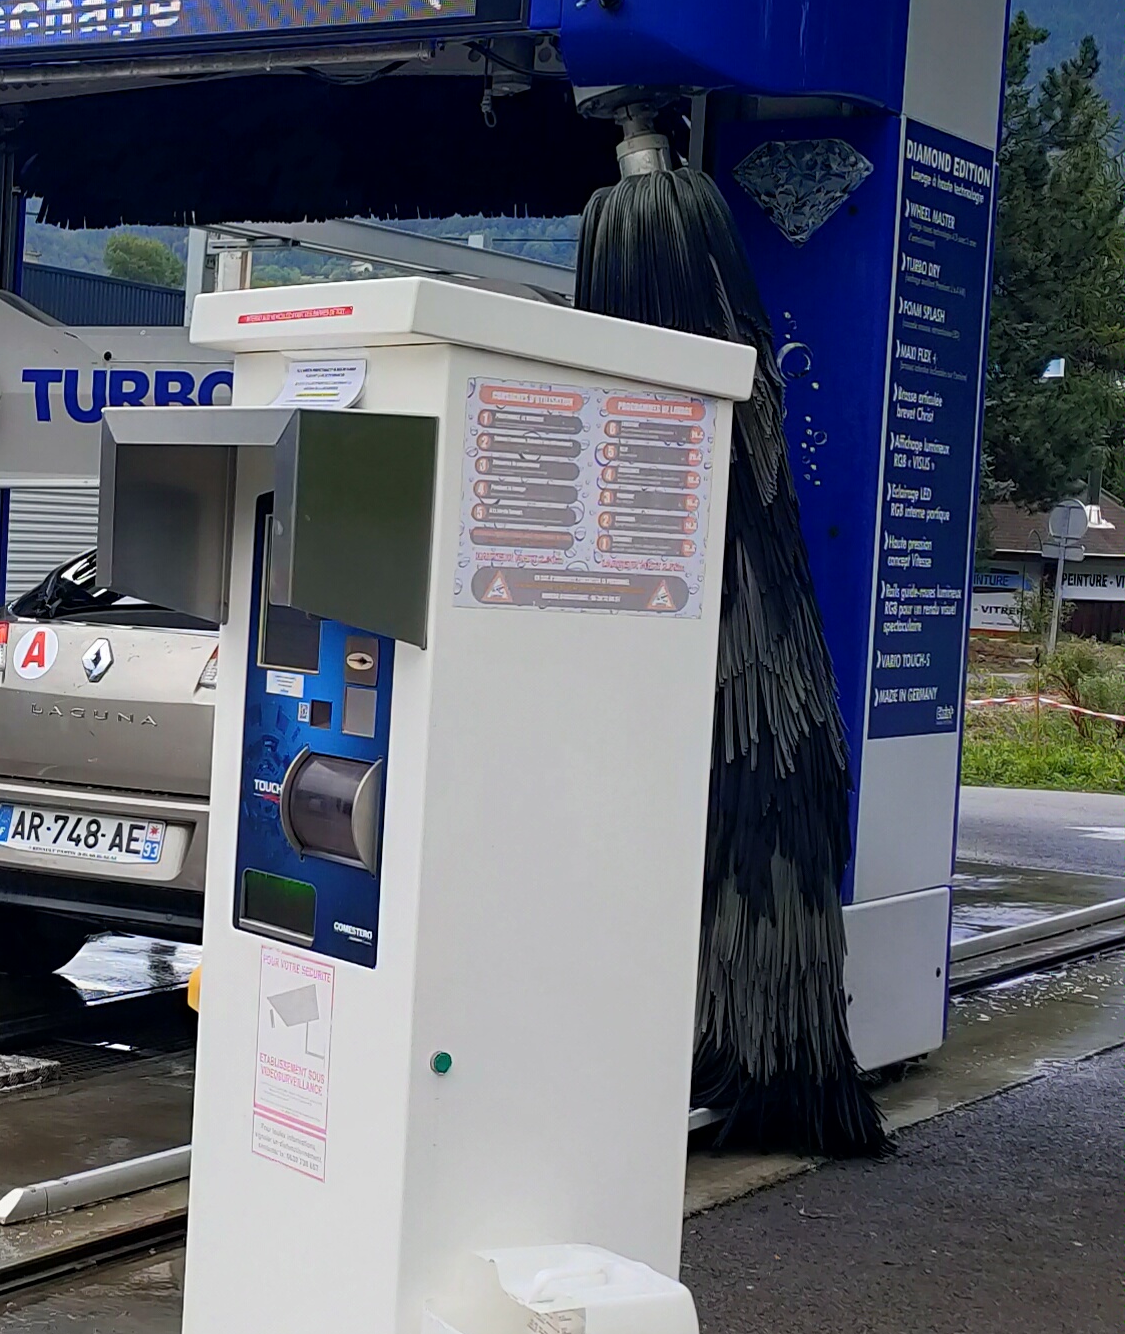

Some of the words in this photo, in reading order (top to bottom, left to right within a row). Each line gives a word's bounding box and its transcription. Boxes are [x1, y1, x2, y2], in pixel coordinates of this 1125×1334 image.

[906, 139, 952, 173] DIAMOND
[952, 157, 991, 188] EDITION
[911, 165, 932, 188] Lavage
[937, 174, 953, 193] haute
[954, 181, 984, 206] technologie
[910, 202, 931, 222] WHEEL
[932, 209, 956, 230] MASTER
[906, 255, 926, 275] TURBO
[928, 262, 941, 279] DRY
[903, 300, 923, 319] FOAM
[923, 305, 946, 324] SPLASH
[900, 343, 917, 361] MAXI
[917, 347, 932, 364] FLEX
[918, 390, 943, 407] articulée
[896, 404, 916, 419] brevet
[917, 407, 935, 422] Christ
[894, 433, 923, 454] Affichage
[923, 437, 950, 455] lumineux
[893, 453, 906, 468] RGB
[920, 486, 932, 501] LED
[890, 503, 903, 517] RGB
[904, 504, 925, 519] interne
[926, 506, 950, 524] portique
[888, 534, 907, 549] Haute
[907, 536, 932, 552] pression
[887, 553, 911, 570] concept
[911, 553, 932, 568] Vitesse
[974, 575, 1009, 586] INTURE
[1062, 573, 1108, 587] PEINTURE
[1115, 575, 1125, 587] VI
[885, 583, 900, 598] Rails
[937, 583, 962, 599] lumineux
[884, 601, 897, 615] RGB
[898, 604, 913, 618] pour
[923, 600, 940, 615] rendu
[981, 605, 1025, 615] VITRER
[882, 618, 922, 636] spectaculaire
[20, 631, 46, 669] A
[881, 654, 901, 669] VARIO
[902, 653, 931, 668] TOUCH-S
[879, 688, 898, 704] MADE
[898, 688, 907, 702] IN
[907, 687, 938, 702] GERMANY
[31, 702, 159, 727] LAGUNA
[11, 810, 147, 856] AR-748-AE
[142, 840, 159, 858] 93
[333, 921, 373, 941] COMESTERO
[263, 953, 279, 968] POUR
[280, 959, 300, 974] VOTRE
[260, 1052, 308, 1077] ETABLISSEMENT
[308, 1069, 325, 1084] SOUS
